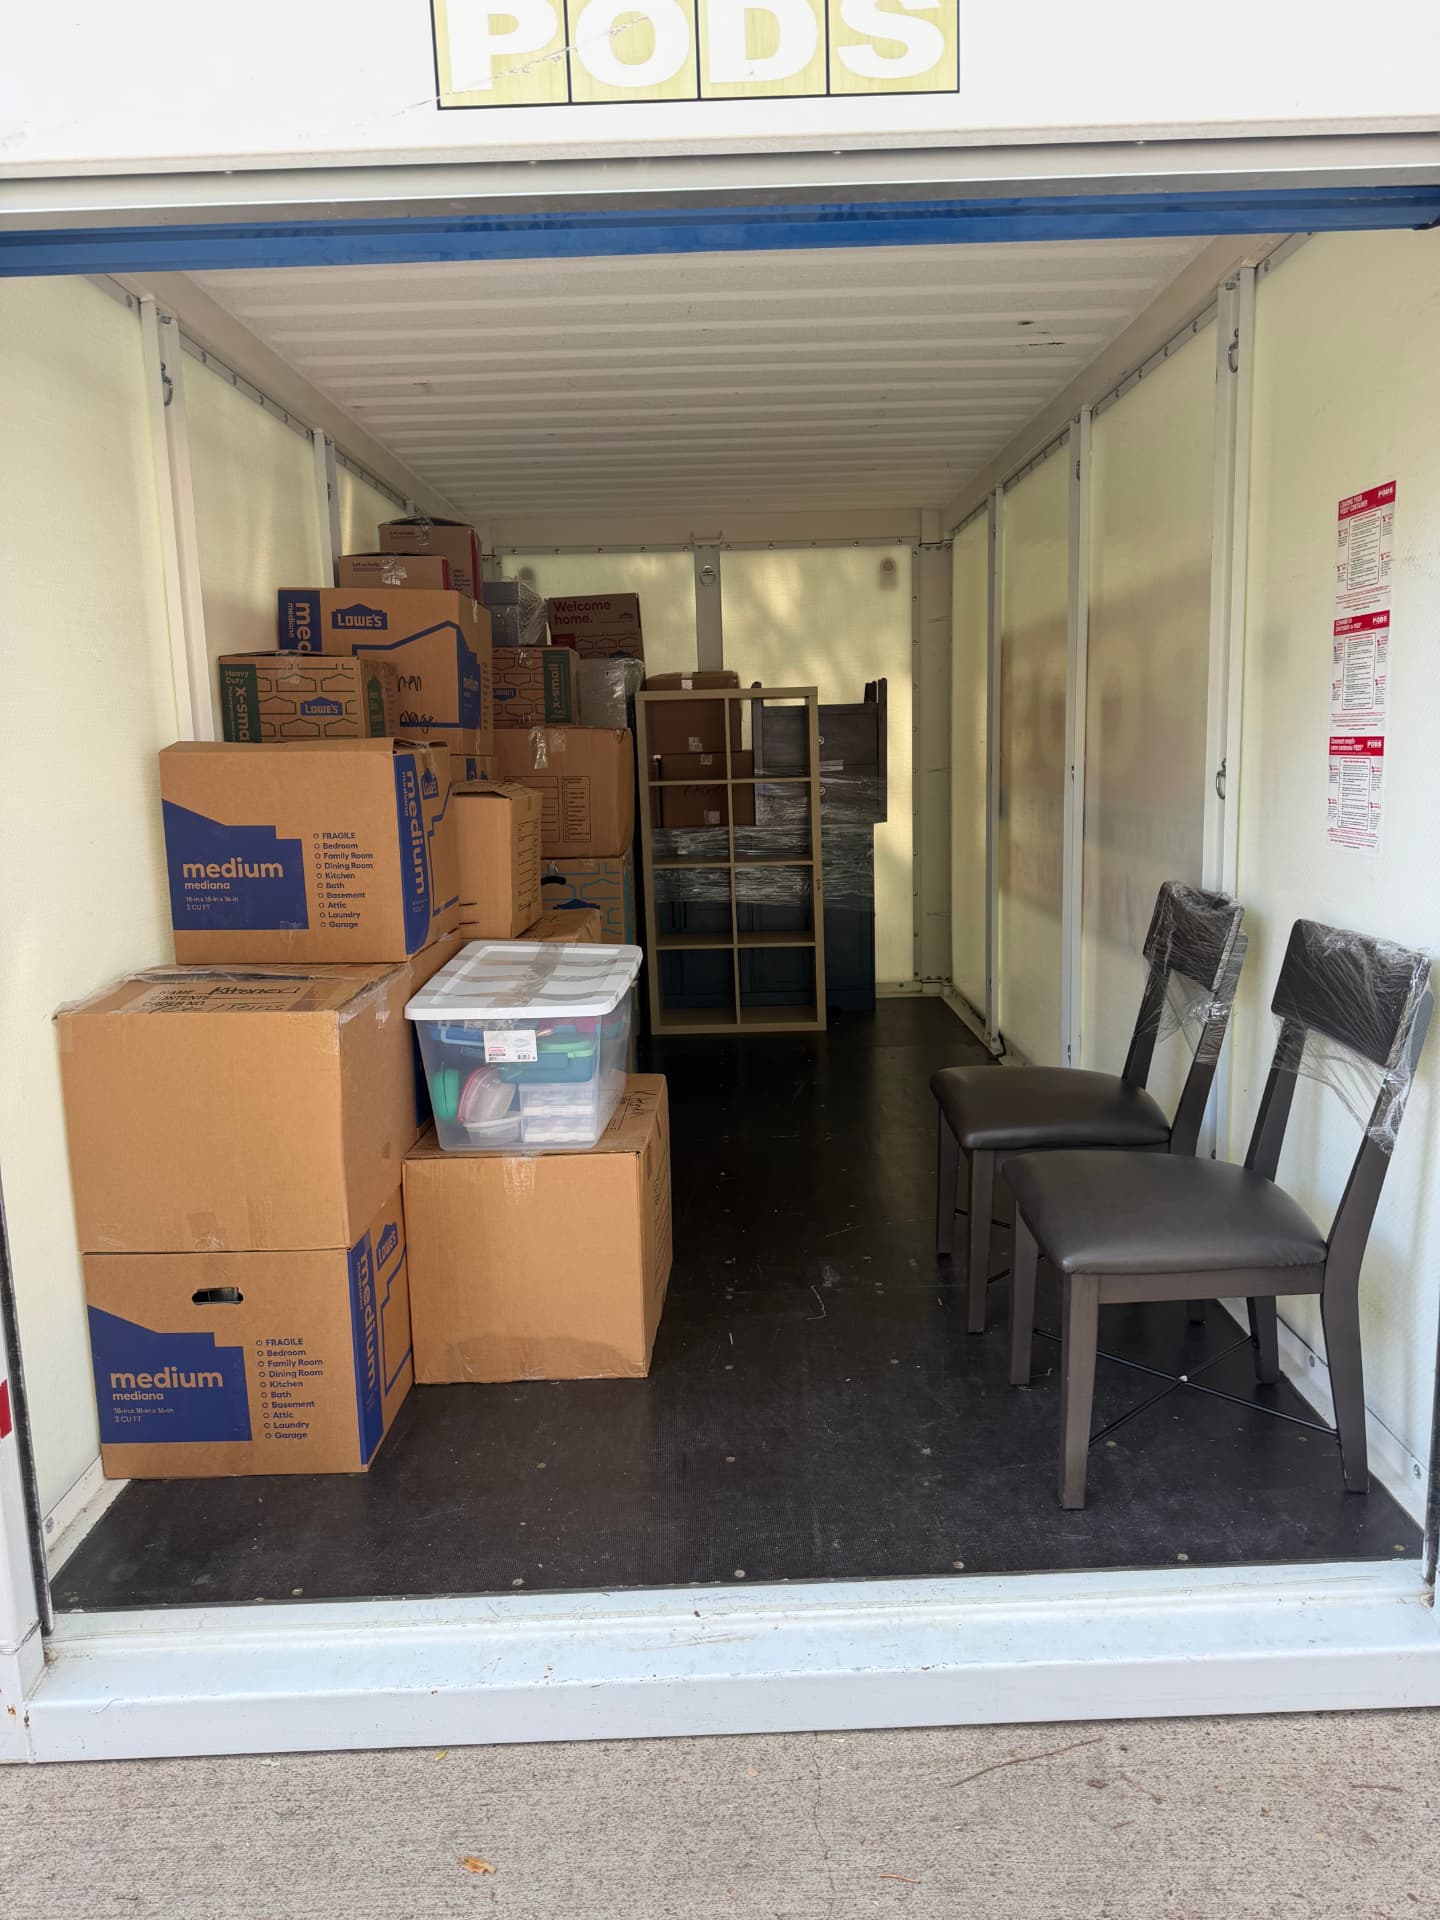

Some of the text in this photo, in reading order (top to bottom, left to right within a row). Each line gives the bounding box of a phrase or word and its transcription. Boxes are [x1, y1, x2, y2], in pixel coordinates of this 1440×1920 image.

[447, 0, 946, 92] PODS
[1377, 487, 1393, 499] PODS
[553, 600, 611, 612] Welcome
[337, 613, 382, 627] LOWE'S
[554, 613, 593, 625] home.
[1372, 615, 1388, 625] PODS
[547, 664, 561, 708] x-small
[304, 703, 339, 714] LOWE'S
[322, 832, 356, 840] FRAGILE
[407, 771, 425, 894] medium
[322, 842, 359, 850] Bedroom
[323, 852, 350, 860] Family
[182, 856, 284, 878] medium
[324, 862, 350, 871] Dining
[325, 872, 356, 880] Kitchen
[184, 880, 231, 890] mediana
[327, 901, 347, 909] Attic
[328, 911, 361, 920] Laundry
[328, 921, 359, 929] Garage
[360, 1251, 376, 1389] medium
[266, 1338, 304, 1346] FRAGILE
[266, 1349, 306, 1357] Bedroom
[267, 1360, 296, 1368] Family
[110, 1366, 224, 1389] medium
[268, 1369, 324, 1378] Dining Room
[269, 1380, 304, 1388] Kitchen
[112, 1391, 164, 1401] mediana
[271, 1401, 315, 1409] Basement
[272, 1411, 294, 1419] Attic
[273, 1421, 310, 1429] Laundry
[274, 1431, 308, 1440] Garage
